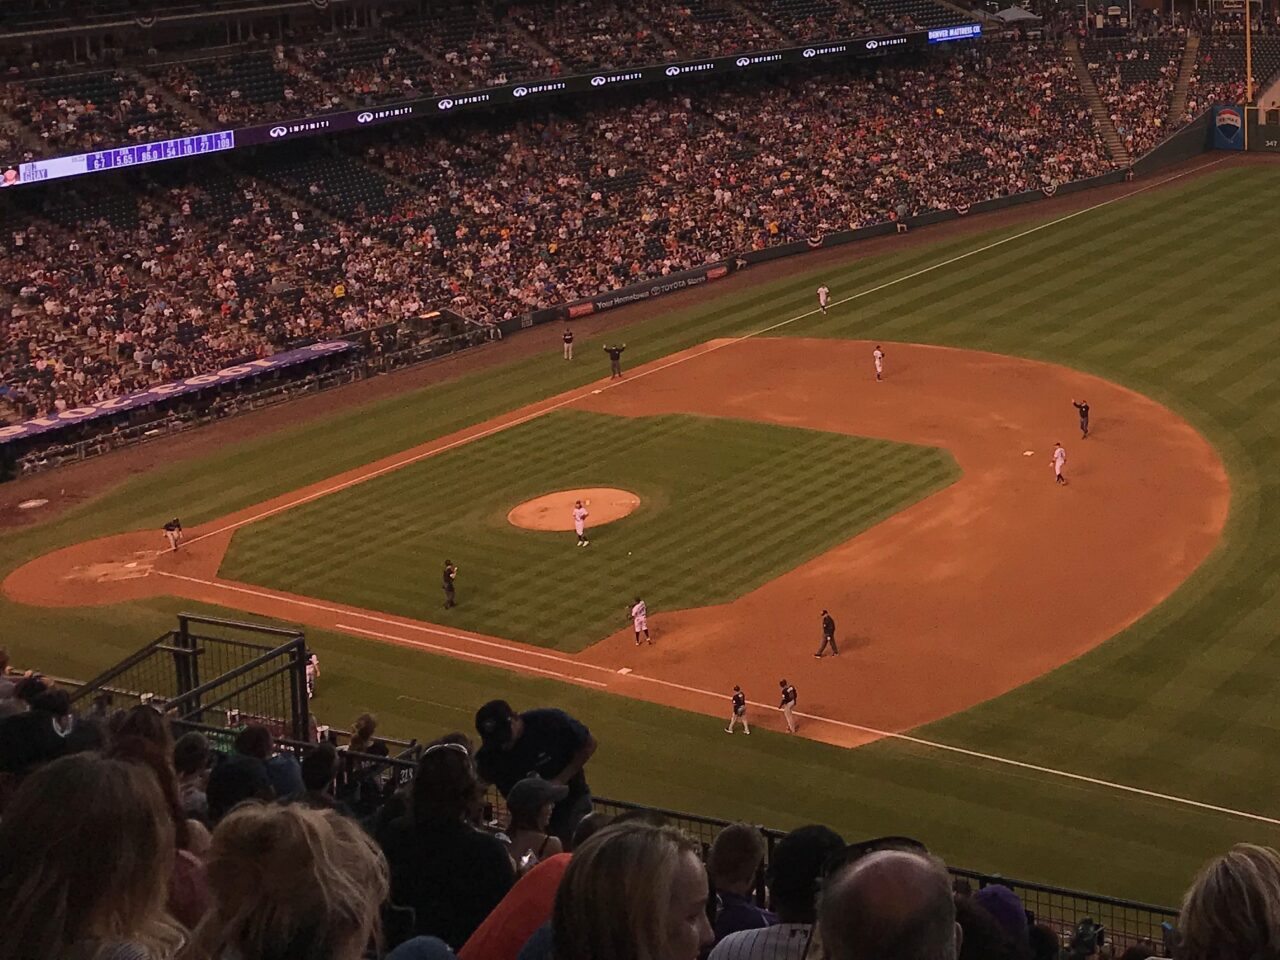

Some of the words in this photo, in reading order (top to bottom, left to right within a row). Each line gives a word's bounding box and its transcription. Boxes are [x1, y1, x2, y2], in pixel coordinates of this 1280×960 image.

[928, 28, 949, 40] DENVER
[950, 26, 973, 39] MATTRESS
[879, 38, 907, 47] INFINITI
[816, 46, 846, 55] INFINITI
[751, 54, 782, 63] INFINITI
[681, 63, 714, 73] INFINITI
[607, 72, 642, 82] INFINITI
[528, 83, 565, 93] INFINITI
[455, 94, 490, 106] INFINITI
[375, 107, 413, 119] INFINITI
[289, 120, 330, 133] INFINITI
[116, 154, 132, 165] 5.65
[167, 147, 176, 157] 54
[183, 145, 192, 154] 10
[200, 142, 209, 151] 27
[217, 138, 230, 150] 109
[597, 298, 613, 310] Your
[614, 290, 650, 305] Hometown
[660, 280, 687, 293] TOYOTA
